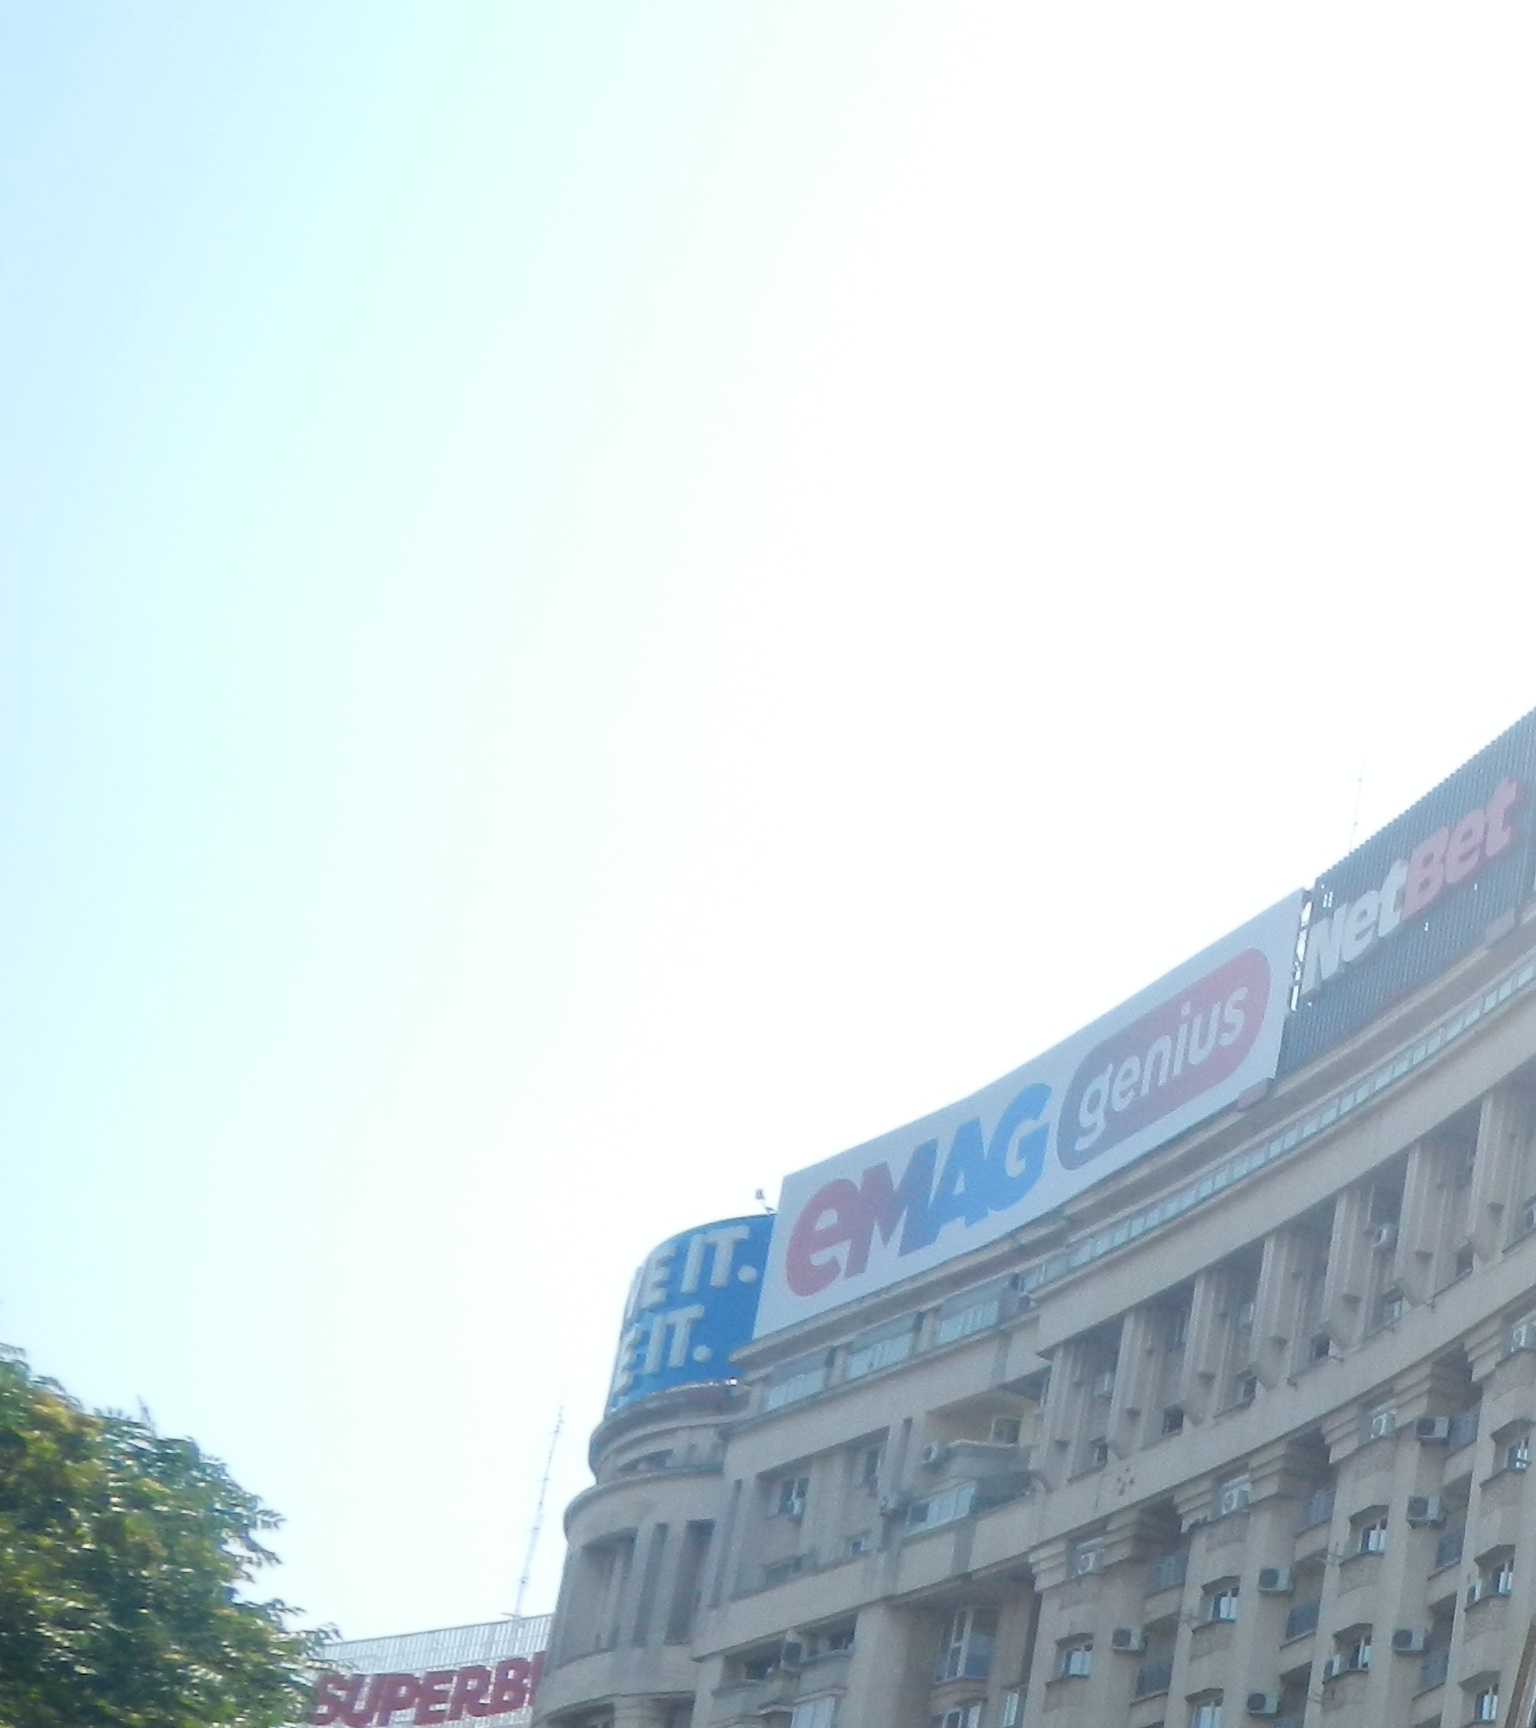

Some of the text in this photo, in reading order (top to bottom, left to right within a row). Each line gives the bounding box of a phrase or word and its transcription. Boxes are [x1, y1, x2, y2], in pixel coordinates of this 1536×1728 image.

[1298, 777, 1525, 998] NetBet
[785, 986, 1248, 1298] eMAG genius
